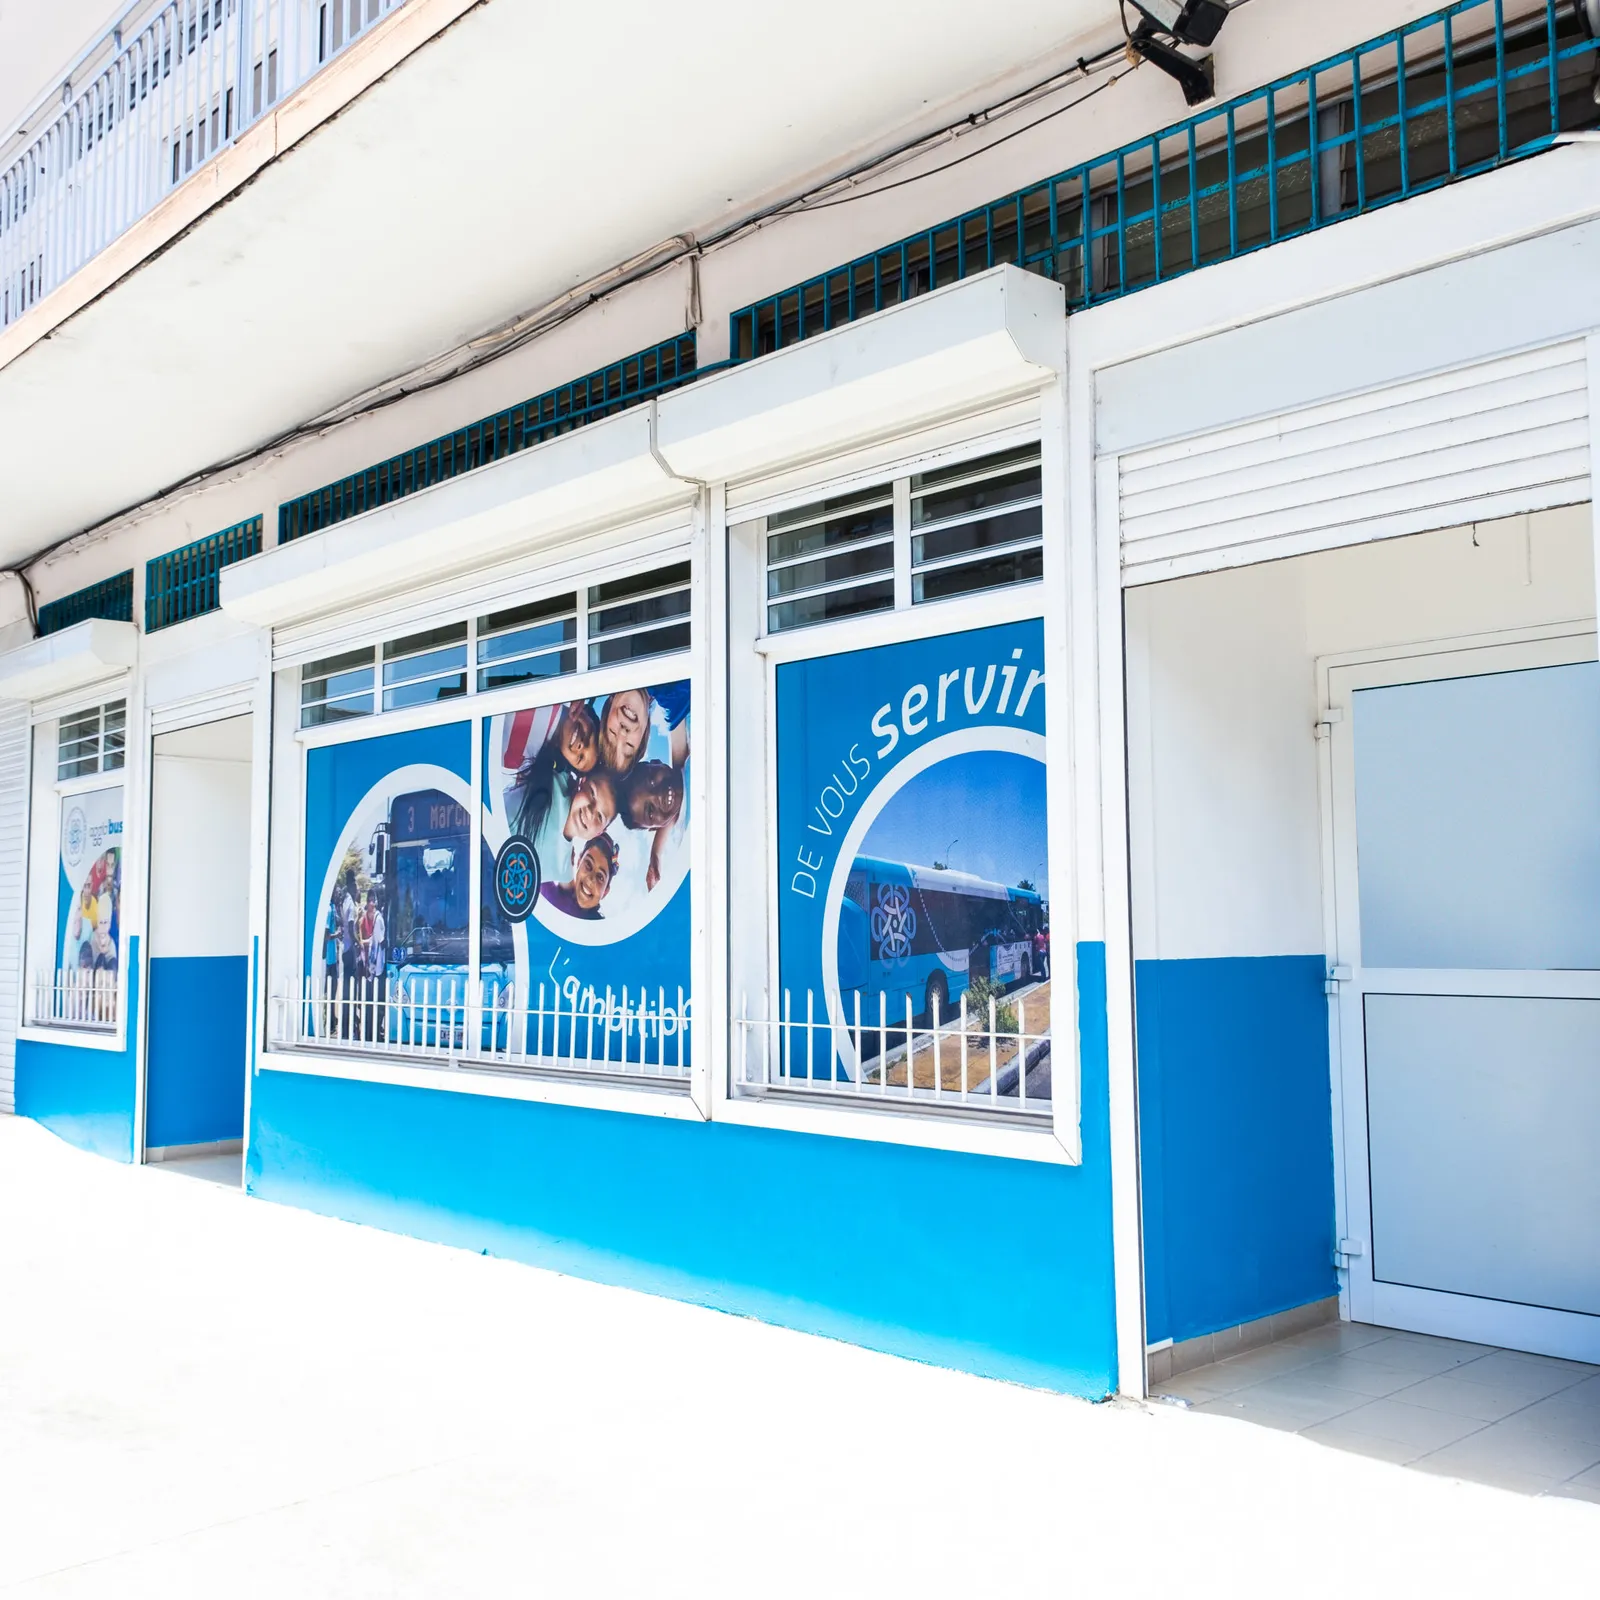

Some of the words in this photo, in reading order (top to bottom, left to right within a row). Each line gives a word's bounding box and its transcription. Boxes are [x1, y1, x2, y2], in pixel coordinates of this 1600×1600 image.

[870, 648, 1046, 760] servir
[807, 743, 871, 836] VOUS
[791, 844, 824, 899] DE
